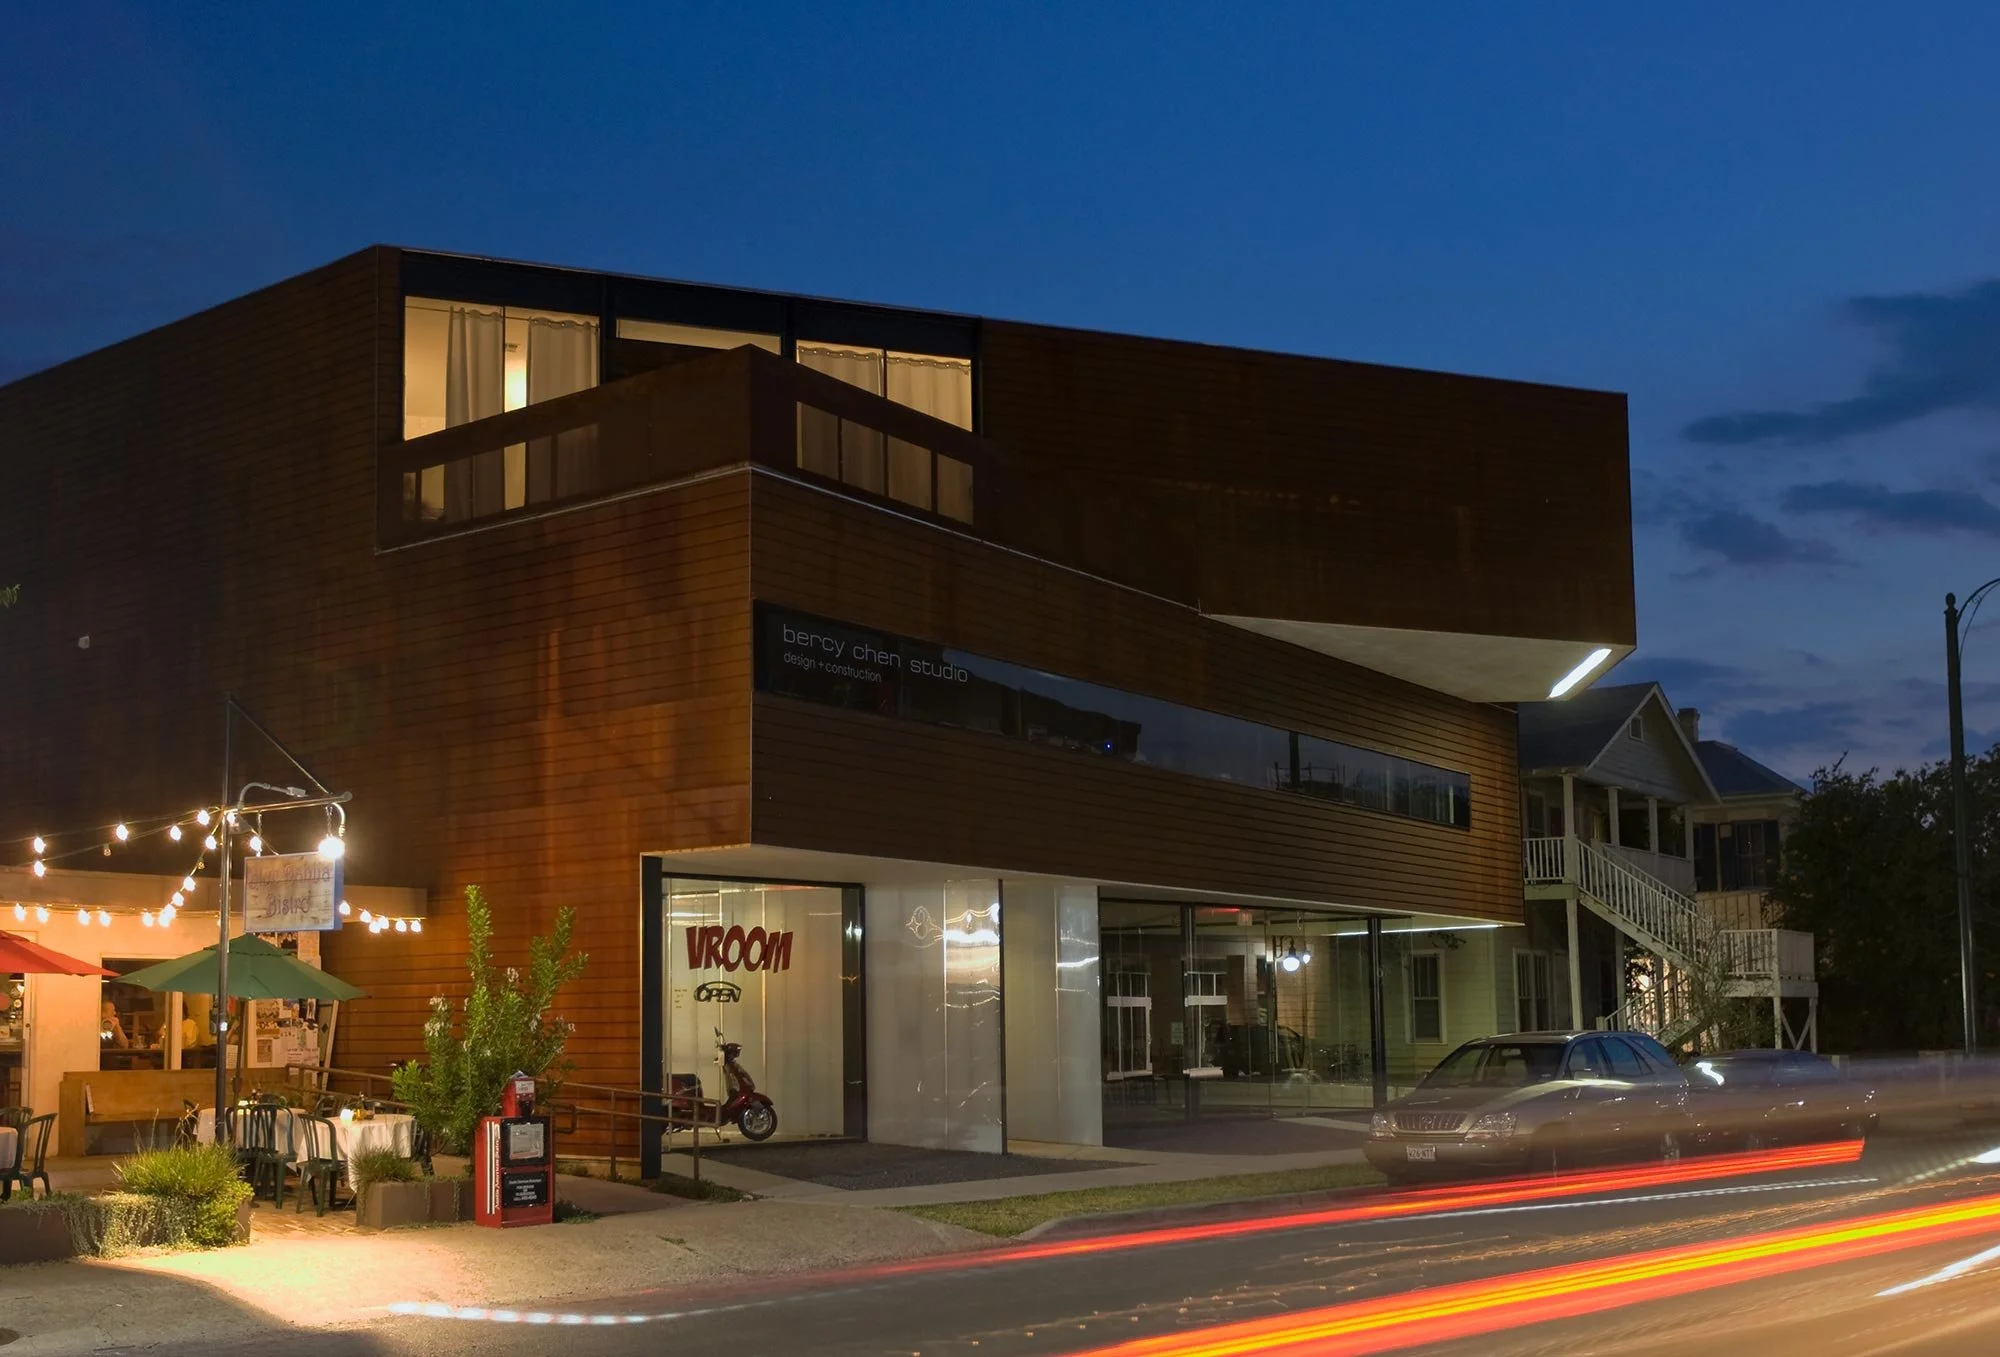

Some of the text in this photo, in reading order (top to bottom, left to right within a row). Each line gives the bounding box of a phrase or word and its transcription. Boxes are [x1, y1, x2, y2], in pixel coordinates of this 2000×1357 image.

[783, 624, 968, 683] bercy chen studio
[783, 651, 816, 671] design
[825, 662, 882, 684] construction
[265, 893, 312, 919] Bistro
[685, 924, 794, 974] VROOM
[694, 982, 742, 1003] OPEN
